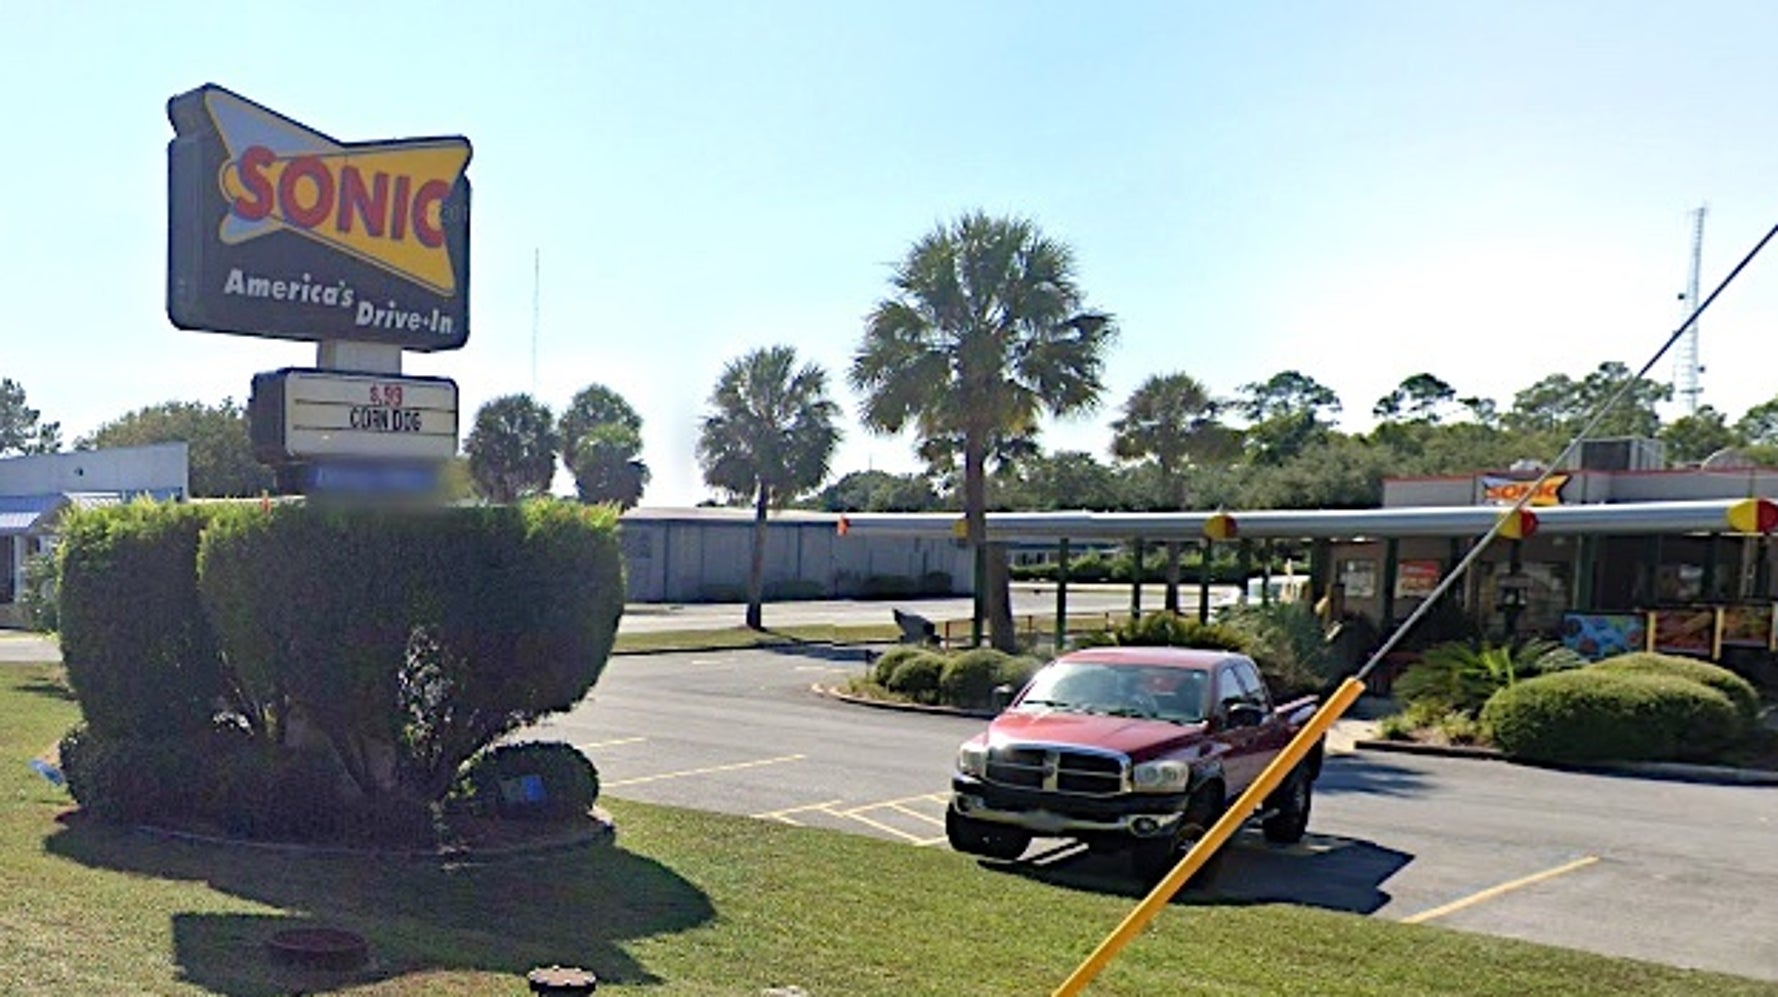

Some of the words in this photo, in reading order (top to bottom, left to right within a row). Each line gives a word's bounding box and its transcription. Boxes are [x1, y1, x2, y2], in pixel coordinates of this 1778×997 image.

[233, 145, 451, 248] SONIC
[225, 268, 354, 307] America's
[350, 407, 388, 429] CORN
[393, 411, 422, 431] DOG
